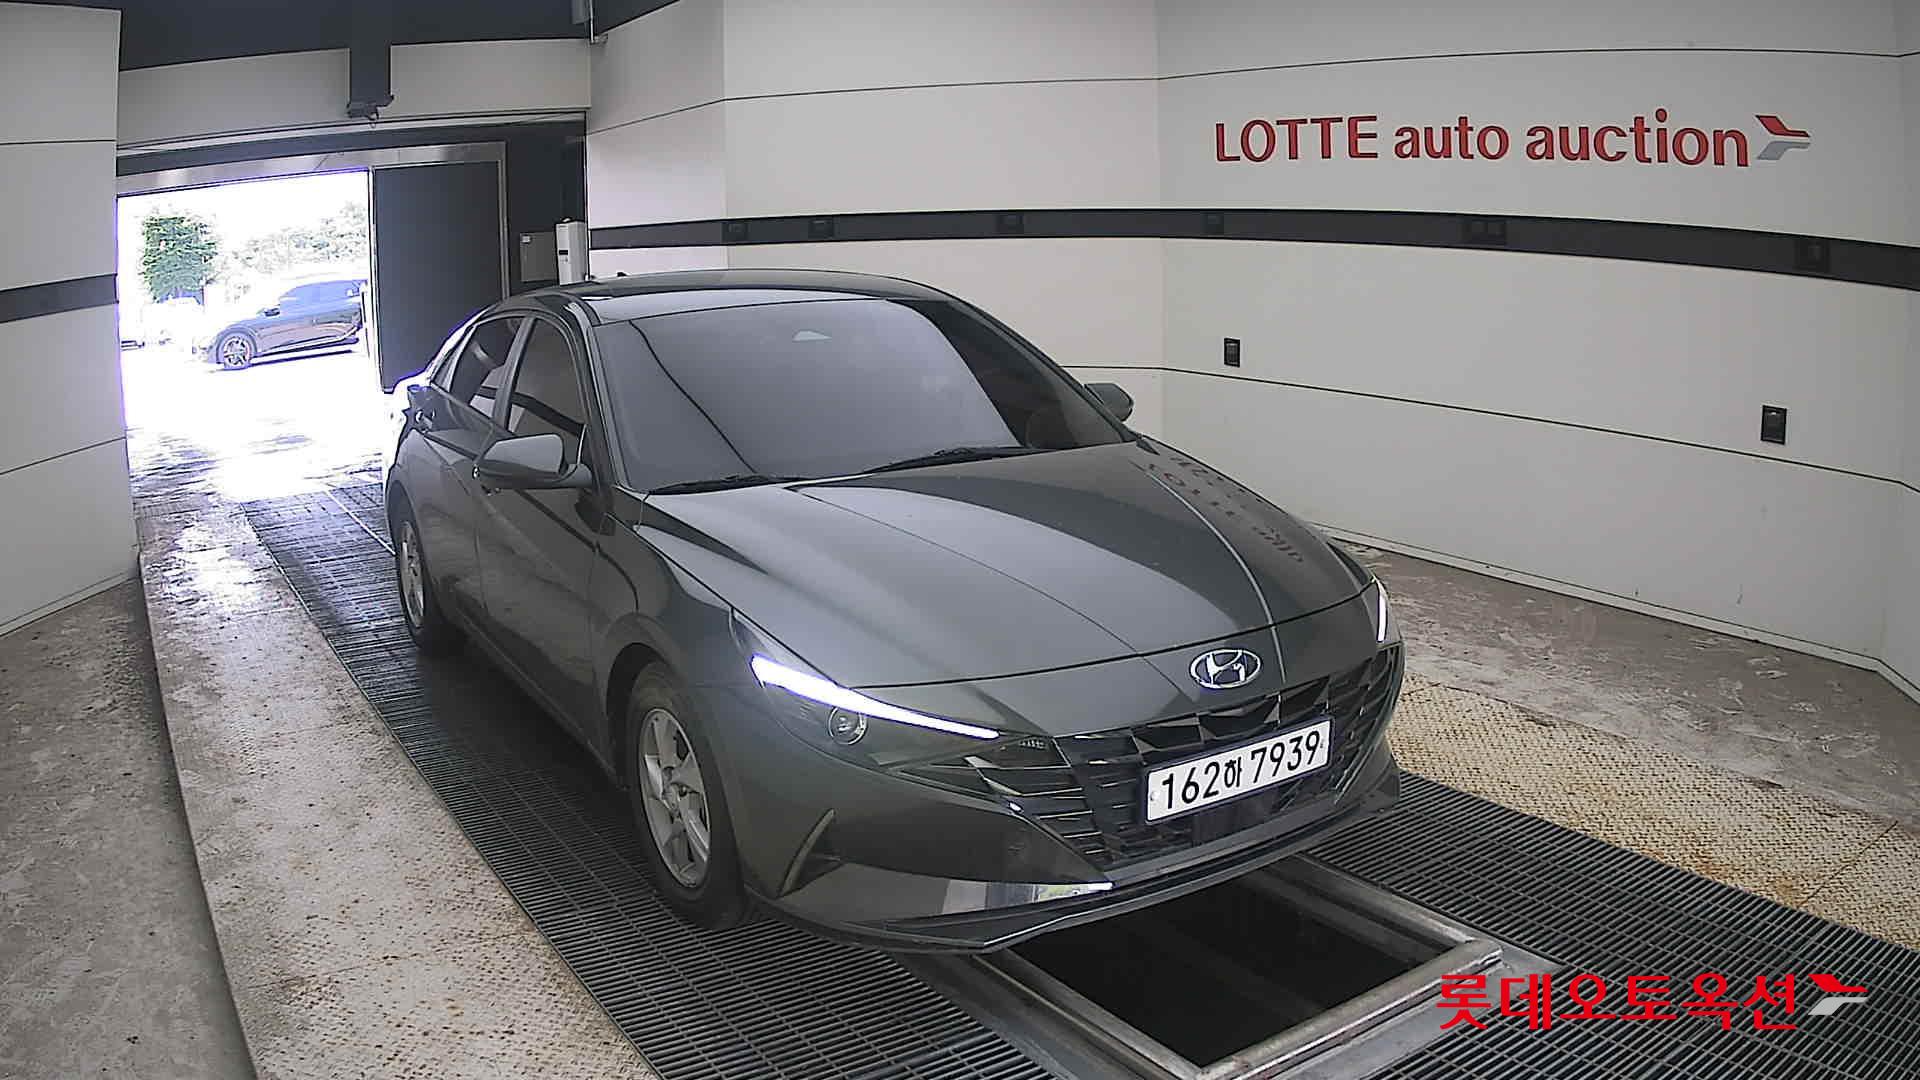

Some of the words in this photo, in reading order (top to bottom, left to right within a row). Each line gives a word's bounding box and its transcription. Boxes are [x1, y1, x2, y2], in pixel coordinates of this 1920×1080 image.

[1215, 115, 1379, 162] LOTTE
[1394, 116, 1510, 160] auto
[1525, 107, 1749, 167] auction
[1161, 756, 1243, 810] 162하
[1250, 730, 1321, 784] 7939
